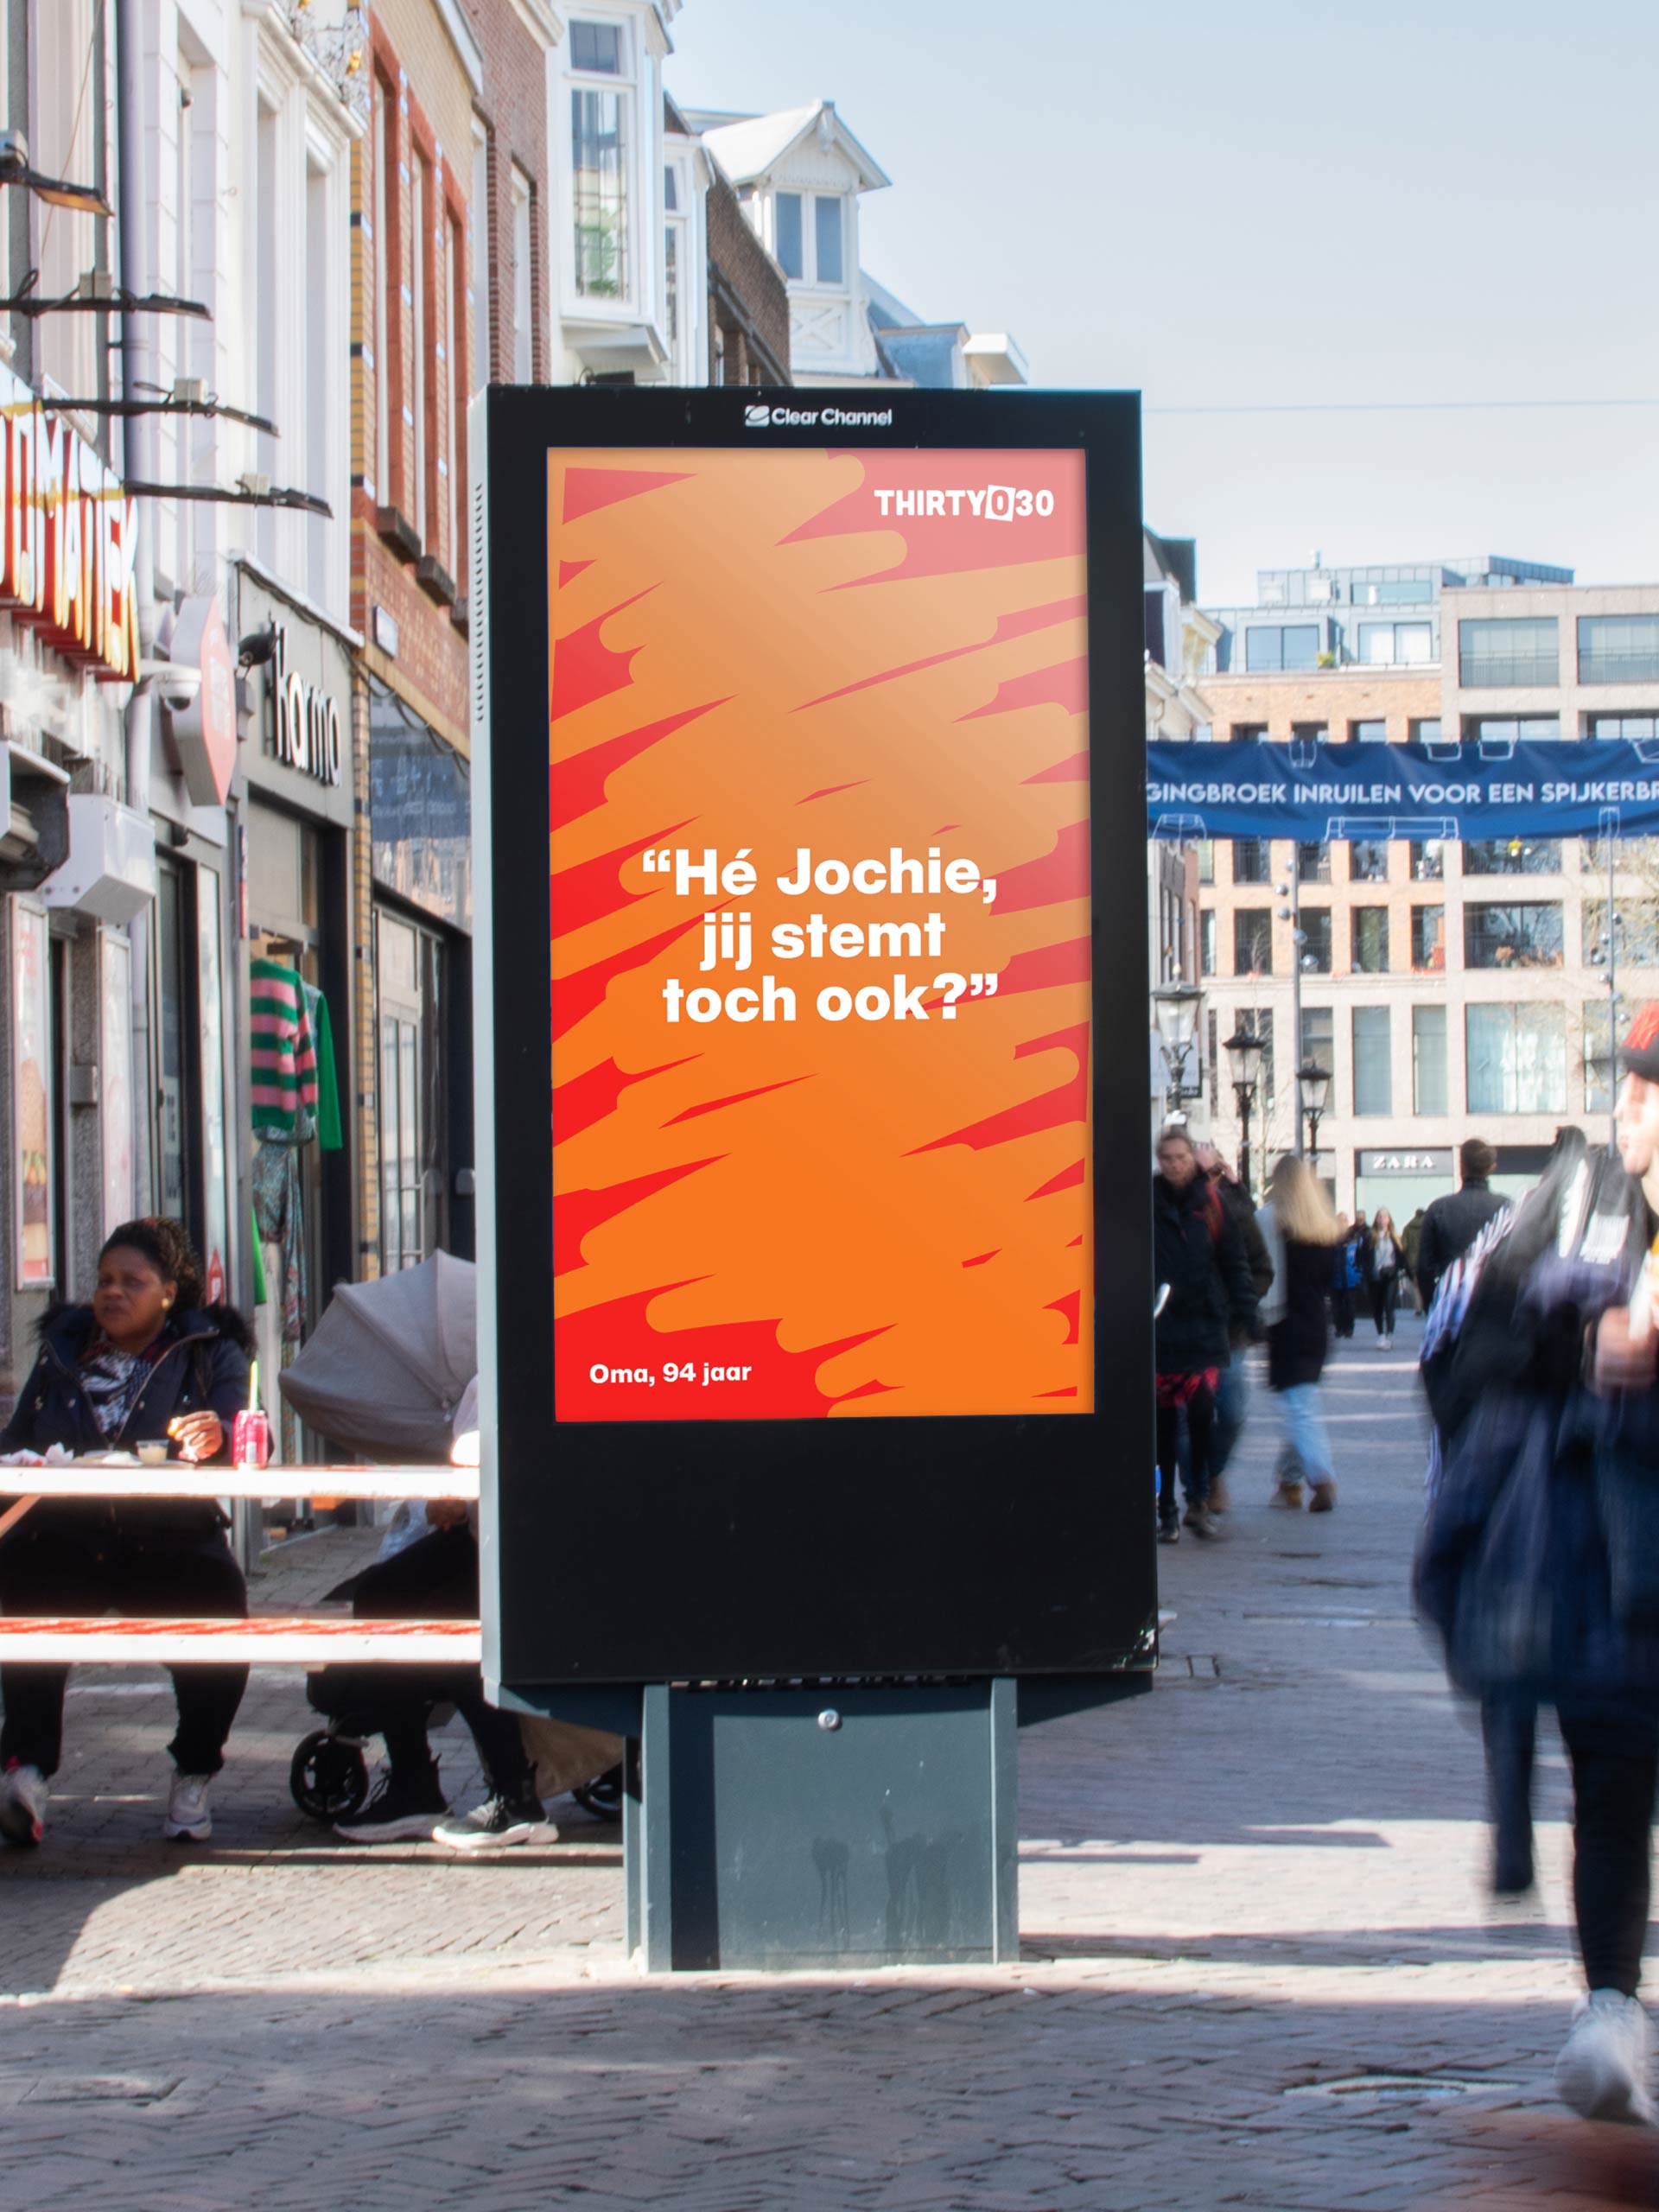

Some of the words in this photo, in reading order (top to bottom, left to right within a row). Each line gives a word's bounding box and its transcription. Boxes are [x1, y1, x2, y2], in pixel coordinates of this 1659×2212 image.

[772, 407, 819, 426] Clear
[821, 407, 893, 426] Channel
[1294, 783, 1401, 804] INRUILEN
[1408, 783, 1482, 804] VOOR
[1488, 782, 1534, 803] EEN
[776, 847, 997, 904] Jochie,
[699, 912, 752, 971] jij
[771, 912, 946, 958] stemt
[662, 975, 797, 1022] toch
[1373, 1154, 1434, 1169] ZARA
[589, 1363, 656, 1387] Oma,
[663, 1362, 696, 1382] 94
[702, 1362, 752, 1386] jaar
